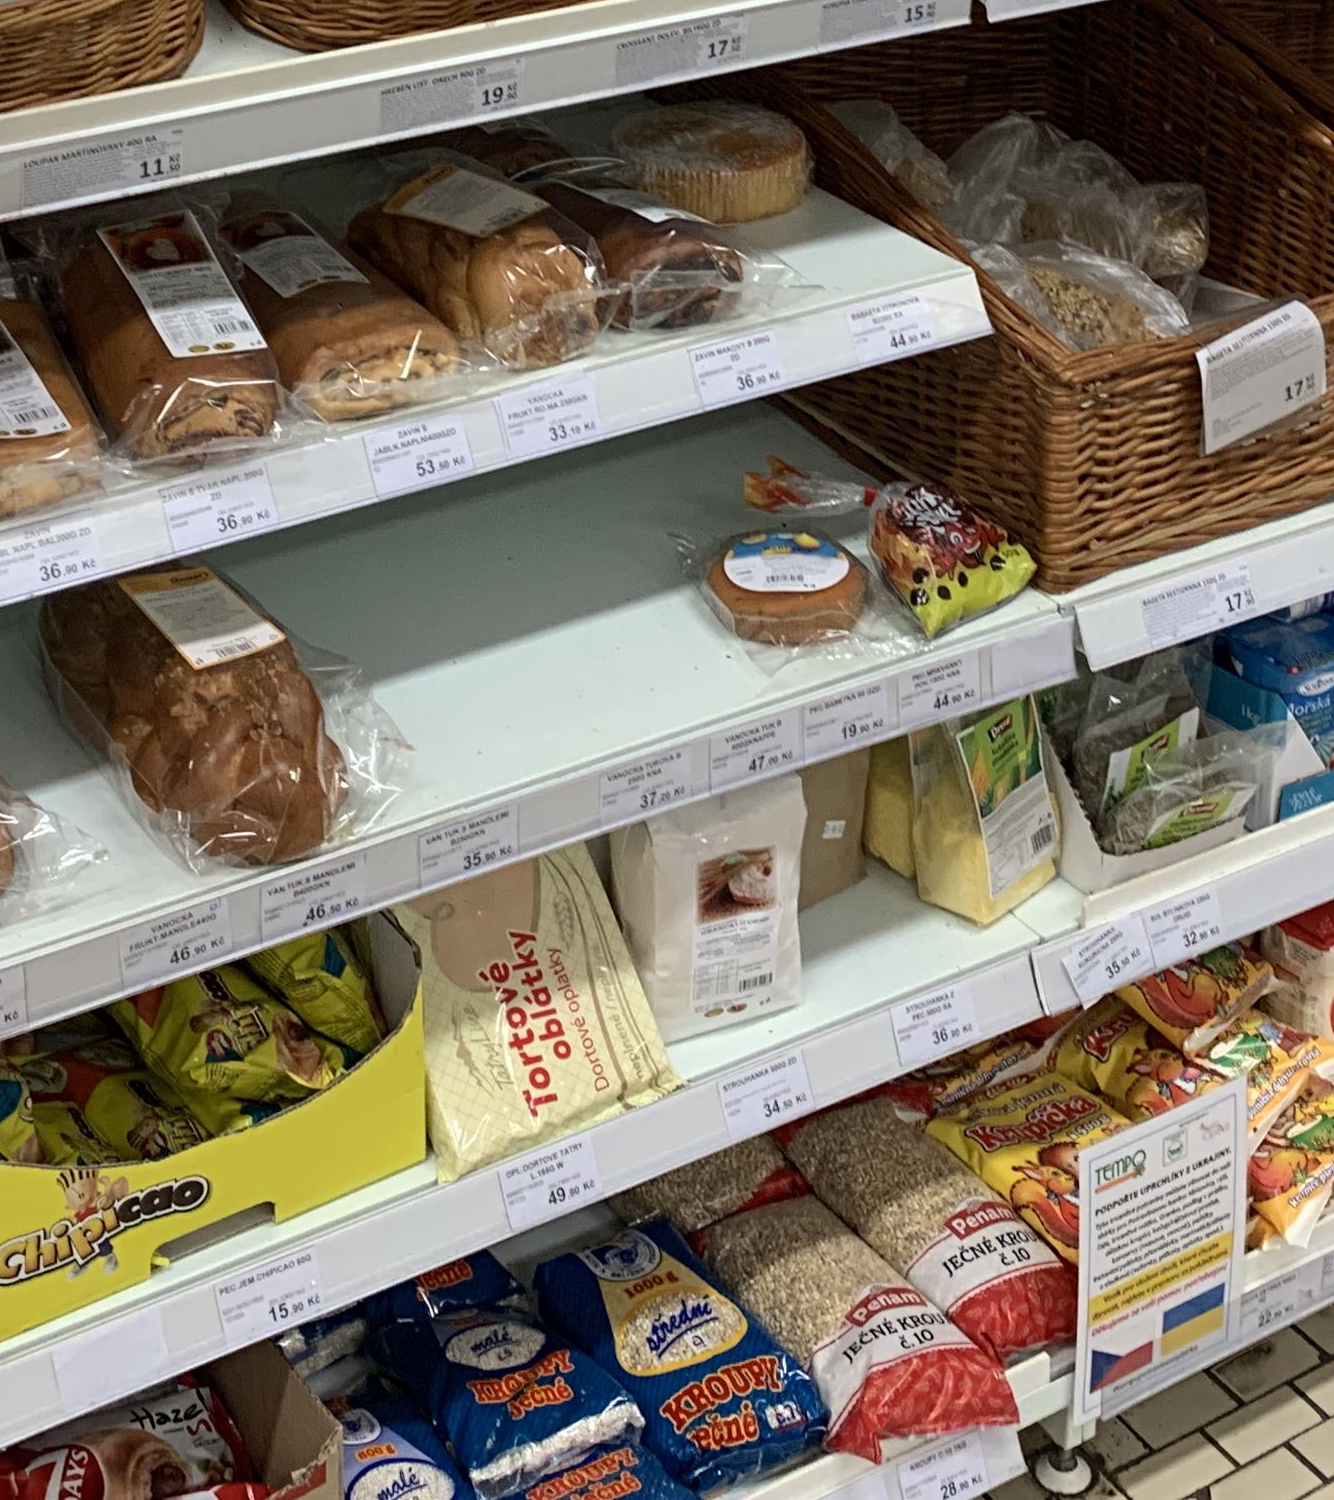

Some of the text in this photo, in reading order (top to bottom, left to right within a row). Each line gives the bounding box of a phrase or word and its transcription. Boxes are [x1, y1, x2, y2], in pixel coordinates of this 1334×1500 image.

[139, 159, 162, 178] 11
[508, 930, 571, 1061] oblátky
[480, 962, 559, 1118] Tortové
[548, 947, 610, 1093] Dortové oplatky
[1096, 1151, 1146, 1186] TEMPO
[950, 1203, 1014, 1236] Penam
[943, 1235, 997, 1277] JEČNÉ
[853, 1291, 923, 1325] Penam
[842, 1317, 897, 1364] JEČNÉ
[470, 1353, 573, 1406] KROUPY
[662, 1356, 779, 1431] KROUPY
